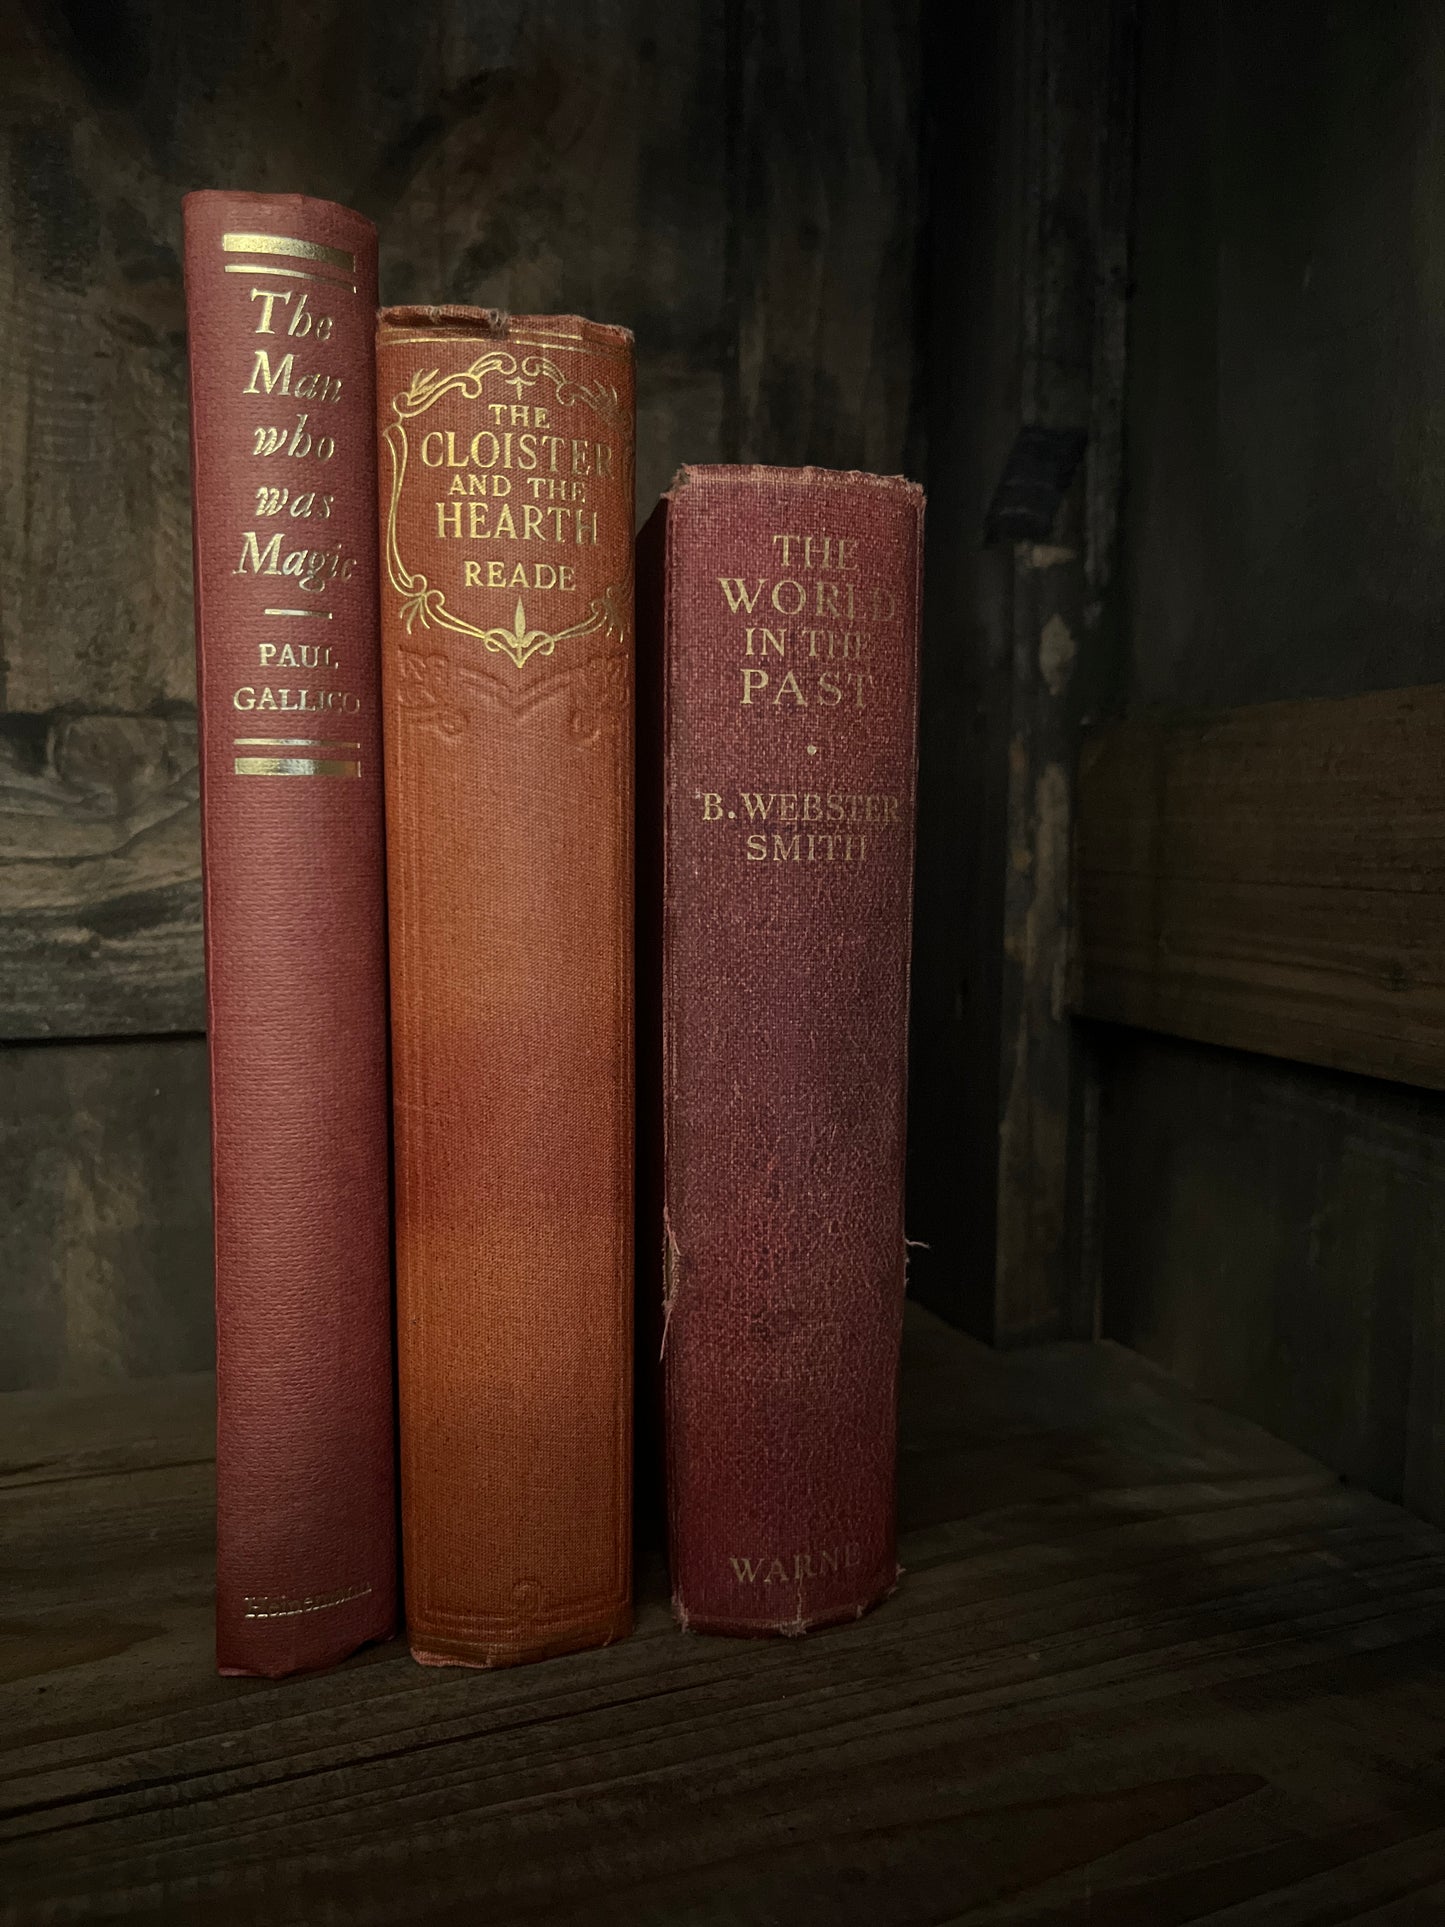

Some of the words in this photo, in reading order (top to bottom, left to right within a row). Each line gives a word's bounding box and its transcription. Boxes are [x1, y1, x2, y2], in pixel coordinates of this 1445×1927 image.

[251, 288, 334, 342] The
[242, 349, 343, 402] Man
[488, 403, 551, 429] THE
[253, 413, 336, 462] who
[420, 431, 613, 480] CLOISTER
[255, 486, 335, 519] was
[449, 474, 512, 497] AND
[526, 477, 586, 504] THE
[435, 502, 598, 545] HEARTH
[232, 531, 358, 593] Magic
[772, 534, 859, 571] THE
[463, 560, 577, 592] READE
[717, 576, 897, 623] WORLD
[258, 643, 340, 669] PAUL
[745, 627, 788, 657] IN
[233, 686, 361, 715] GALLICO
[740, 668, 876, 710] PAST
[741, 792, 901, 823] WEBSTER
[746, 834, 867, 861] SMITH
[729, 1541, 862, 1584] WARNE
